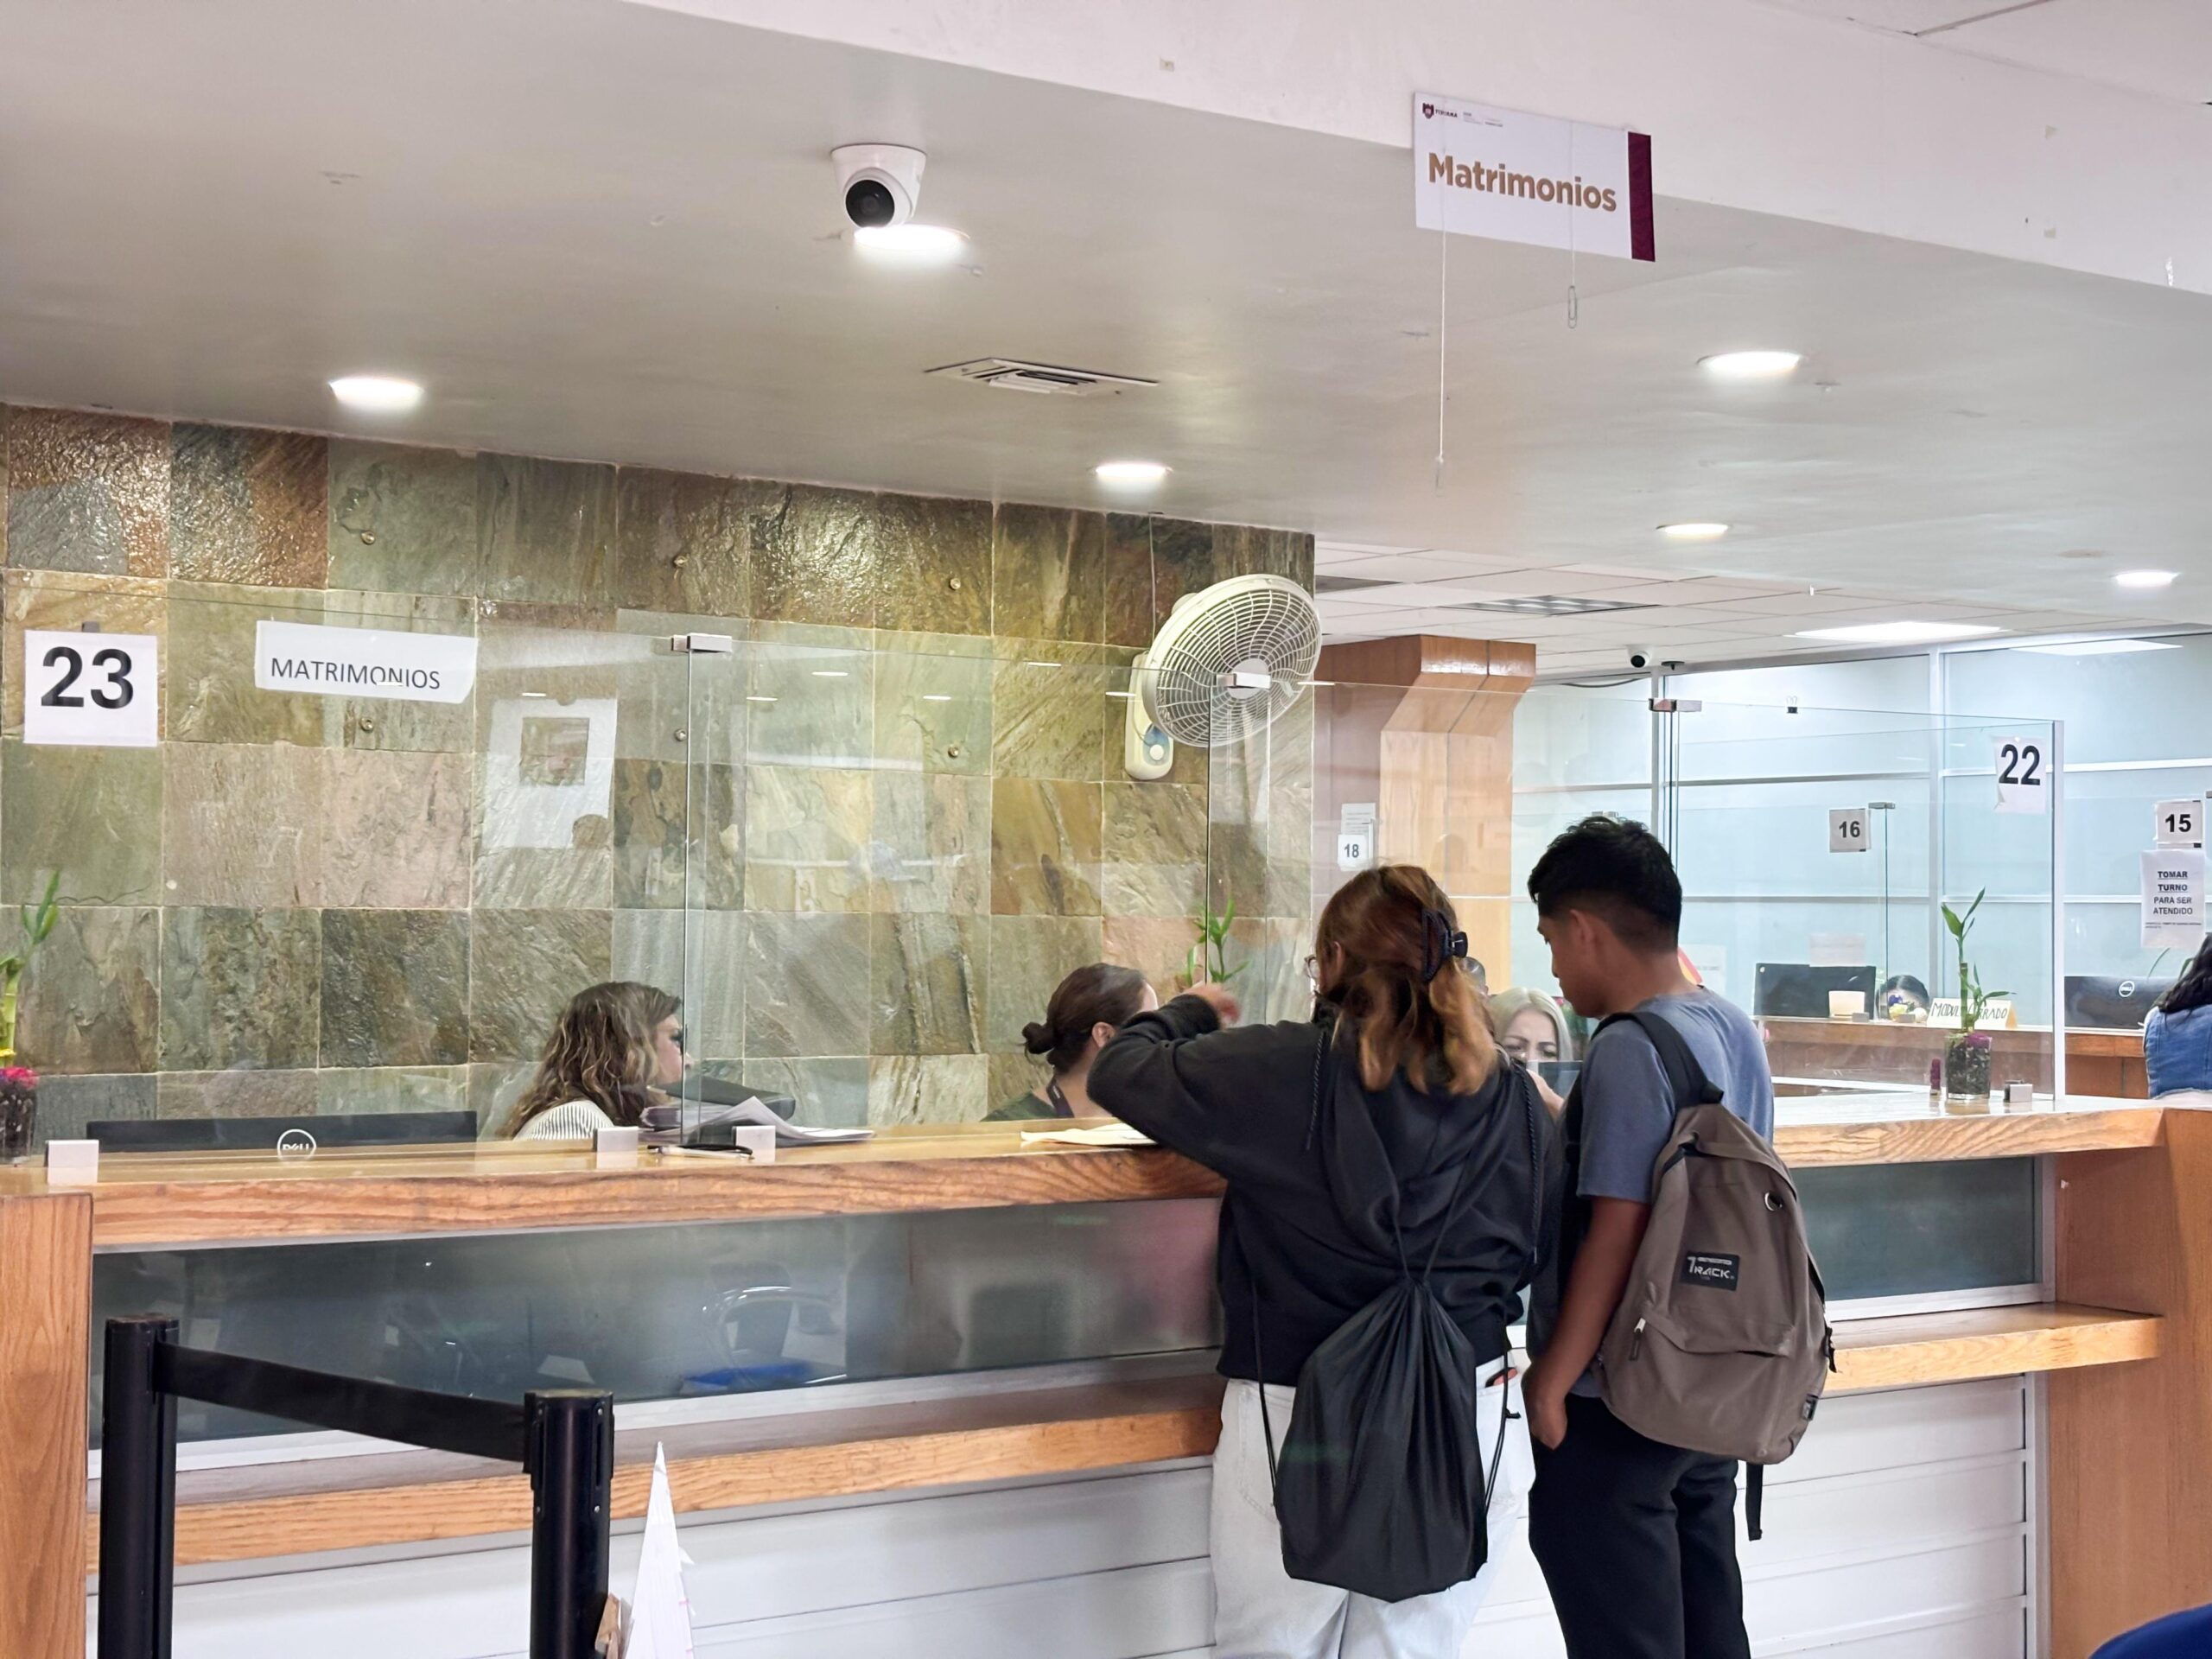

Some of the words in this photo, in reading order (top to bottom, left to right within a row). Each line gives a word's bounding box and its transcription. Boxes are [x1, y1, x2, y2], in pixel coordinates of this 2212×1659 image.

[1428, 152, 1617, 212] Matrimonios
[41, 646, 133, 709] 23
[270, 658, 440, 690] MATRIMONIOS
[1999, 744, 2040, 785] 22
[1839, 821, 1860, 838] 16
[2165, 814, 2192, 832] 15
[1344, 843, 1359, 858] 18
[1931, 1002, 1961, 1017] MODUL
[1687, 1256, 1731, 1279] TRACK
